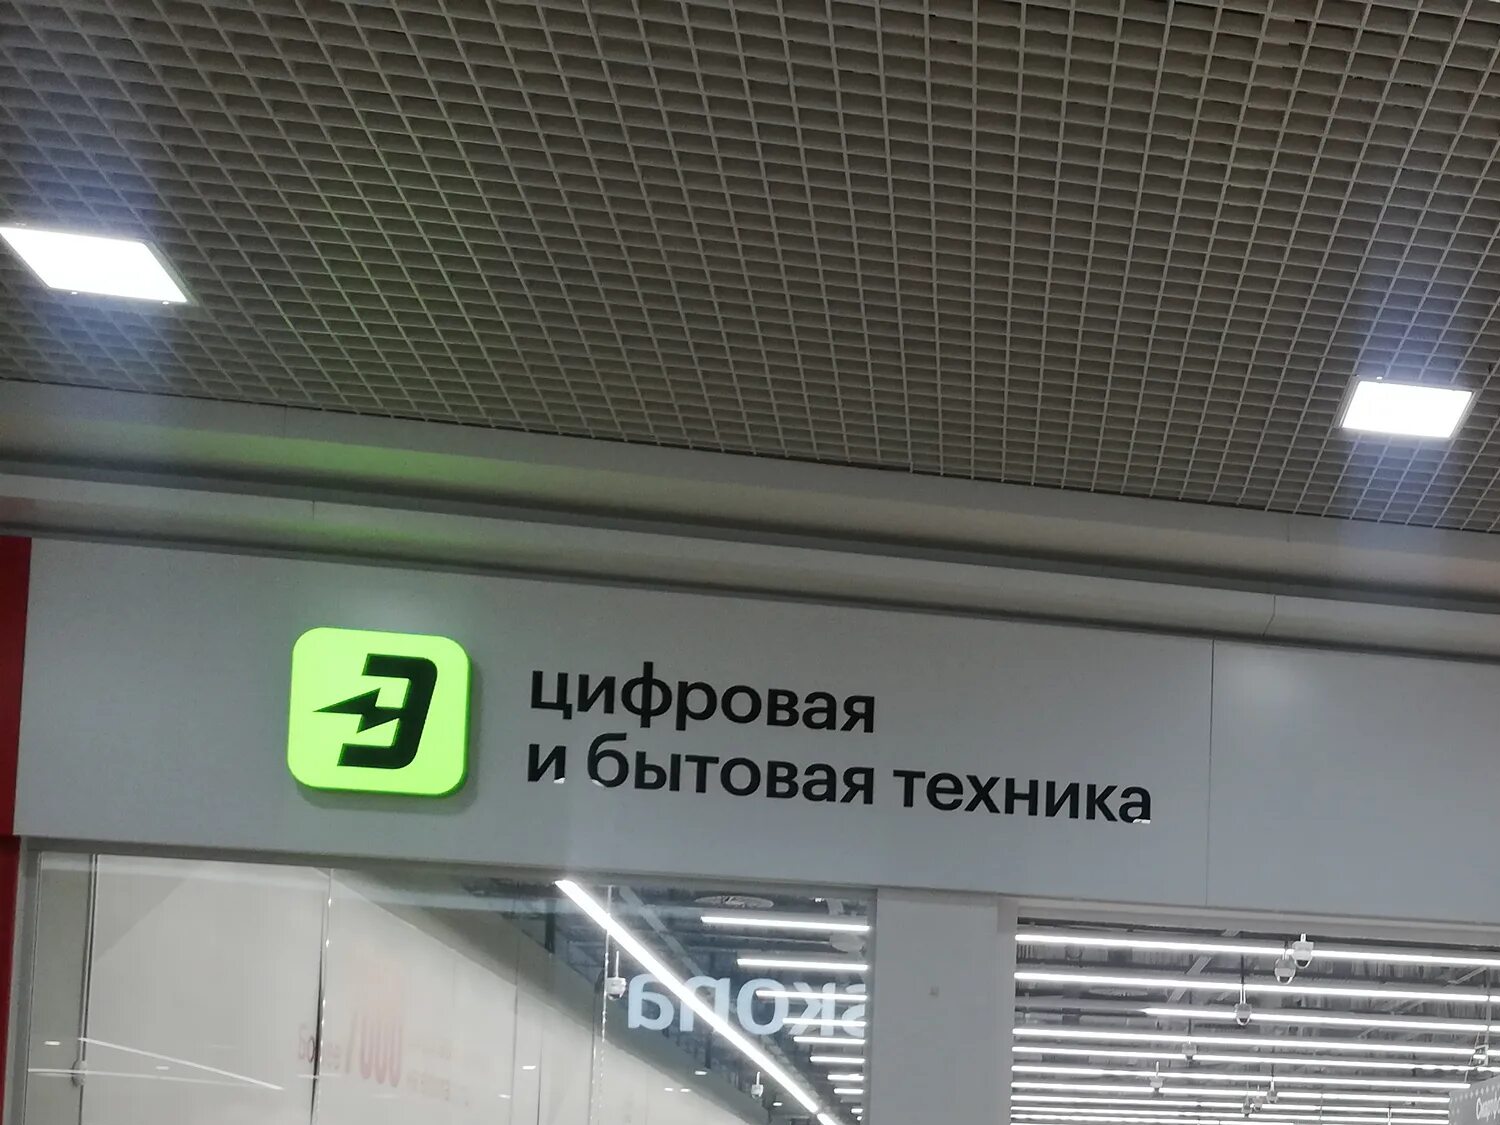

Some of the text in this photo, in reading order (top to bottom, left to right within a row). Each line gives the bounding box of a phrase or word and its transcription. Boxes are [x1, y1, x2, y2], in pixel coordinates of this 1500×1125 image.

[530, 660, 877, 734] цифровая
[527, 732, 1153, 825] и бытовая техника
